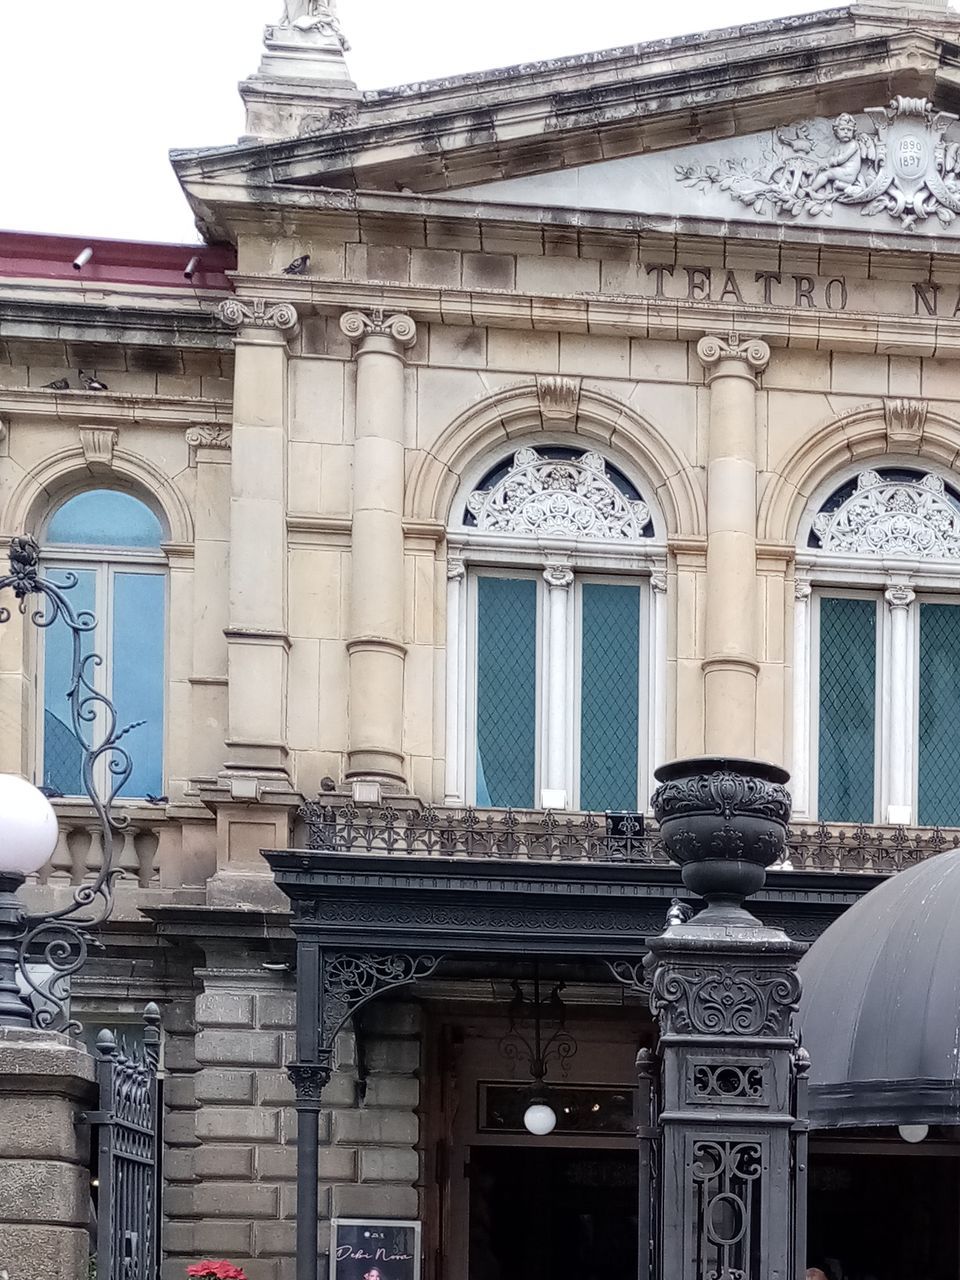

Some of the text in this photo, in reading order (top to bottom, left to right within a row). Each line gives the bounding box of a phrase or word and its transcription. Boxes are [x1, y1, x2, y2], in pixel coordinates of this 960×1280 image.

[900, 140, 922, 151] 1890
[900, 155, 921, 168] 1897
[644, 263, 848, 311] TEATRO
[335, 1245, 413, 1261] Debi Nova
